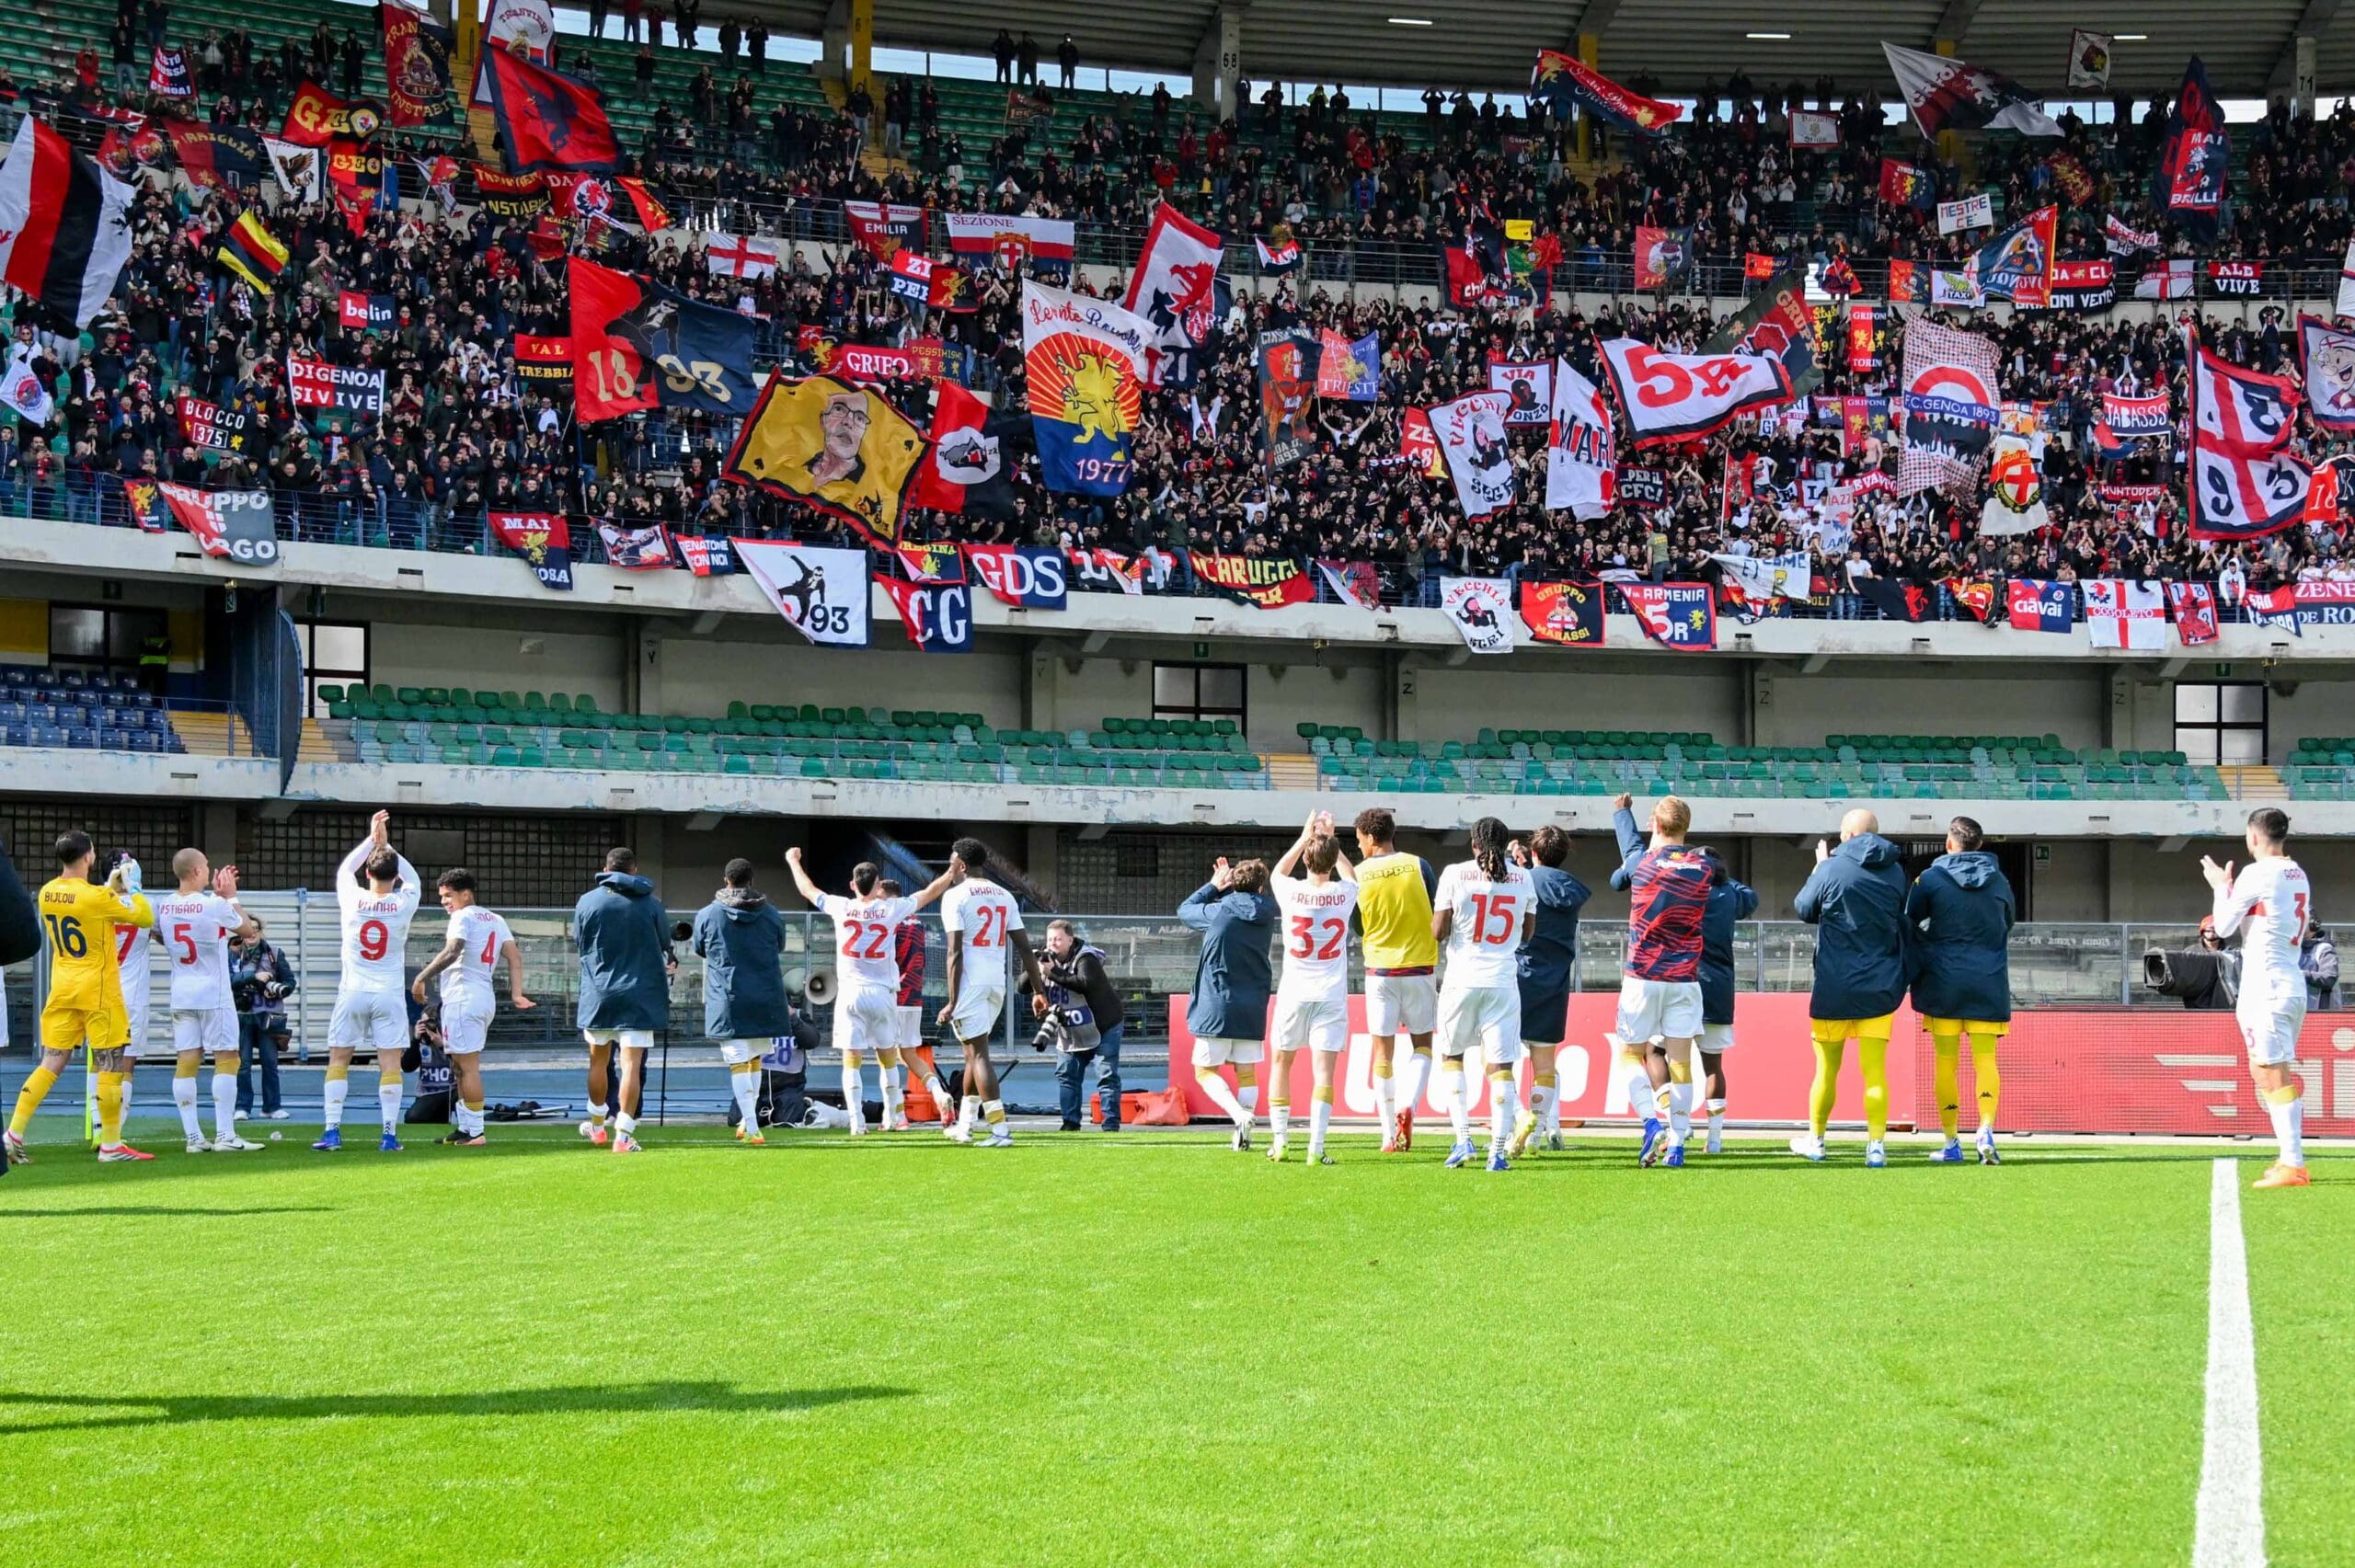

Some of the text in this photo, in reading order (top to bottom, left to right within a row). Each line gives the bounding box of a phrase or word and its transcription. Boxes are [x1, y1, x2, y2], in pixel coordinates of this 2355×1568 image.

[1223, 52, 1236, 68] 68
[1941, 196, 1988, 220] MESTRE
[2170, 193, 2218, 205] BRILLI
[864, 223, 908, 235] EMILIA
[953, 216, 1016, 228] SEZIONE
[2214, 279, 2260, 294] VIVE
[345, 298, 392, 322] belin
[531, 343, 565, 356] VAL
[1501, 368, 1536, 382] VIA
[1321, 378, 1377, 395] TRIESTE
[186, 399, 246, 430] BLOCCO
[1971, 406, 1997, 421] 1893
[197, 425, 224, 446] 375
[1076, 458, 1131, 484] 1977
[1621, 484, 1663, 503] CFC!
[501, 517, 551, 531] MAI
[971, 552, 1066, 598] GDS
[1535, 584, 1586, 604] GRUPPO
[1644, 587, 1706, 602] ARMENIA
[810, 603, 850, 635] 93
[1534, 622, 1591, 643] MARASSI
[44, 891, 76, 905] BIJLOW
[357, 900, 398, 913] VITINHA
[1290, 891, 1347, 907] FRENDRUP
[972, 905, 1008, 947] 21
[1471, 893, 1516, 945] 15
[2291, 892, 2307, 946] 3
[44, 913, 88, 958] 16
[174, 922, 198, 965] 5
[359, 920, 388, 961] 9
[842, 919, 889, 959] 22
[1289, 915, 1347, 961] 32
[480, 931, 496, 965] 4
[2246, 1027, 2255, 1047] 3
